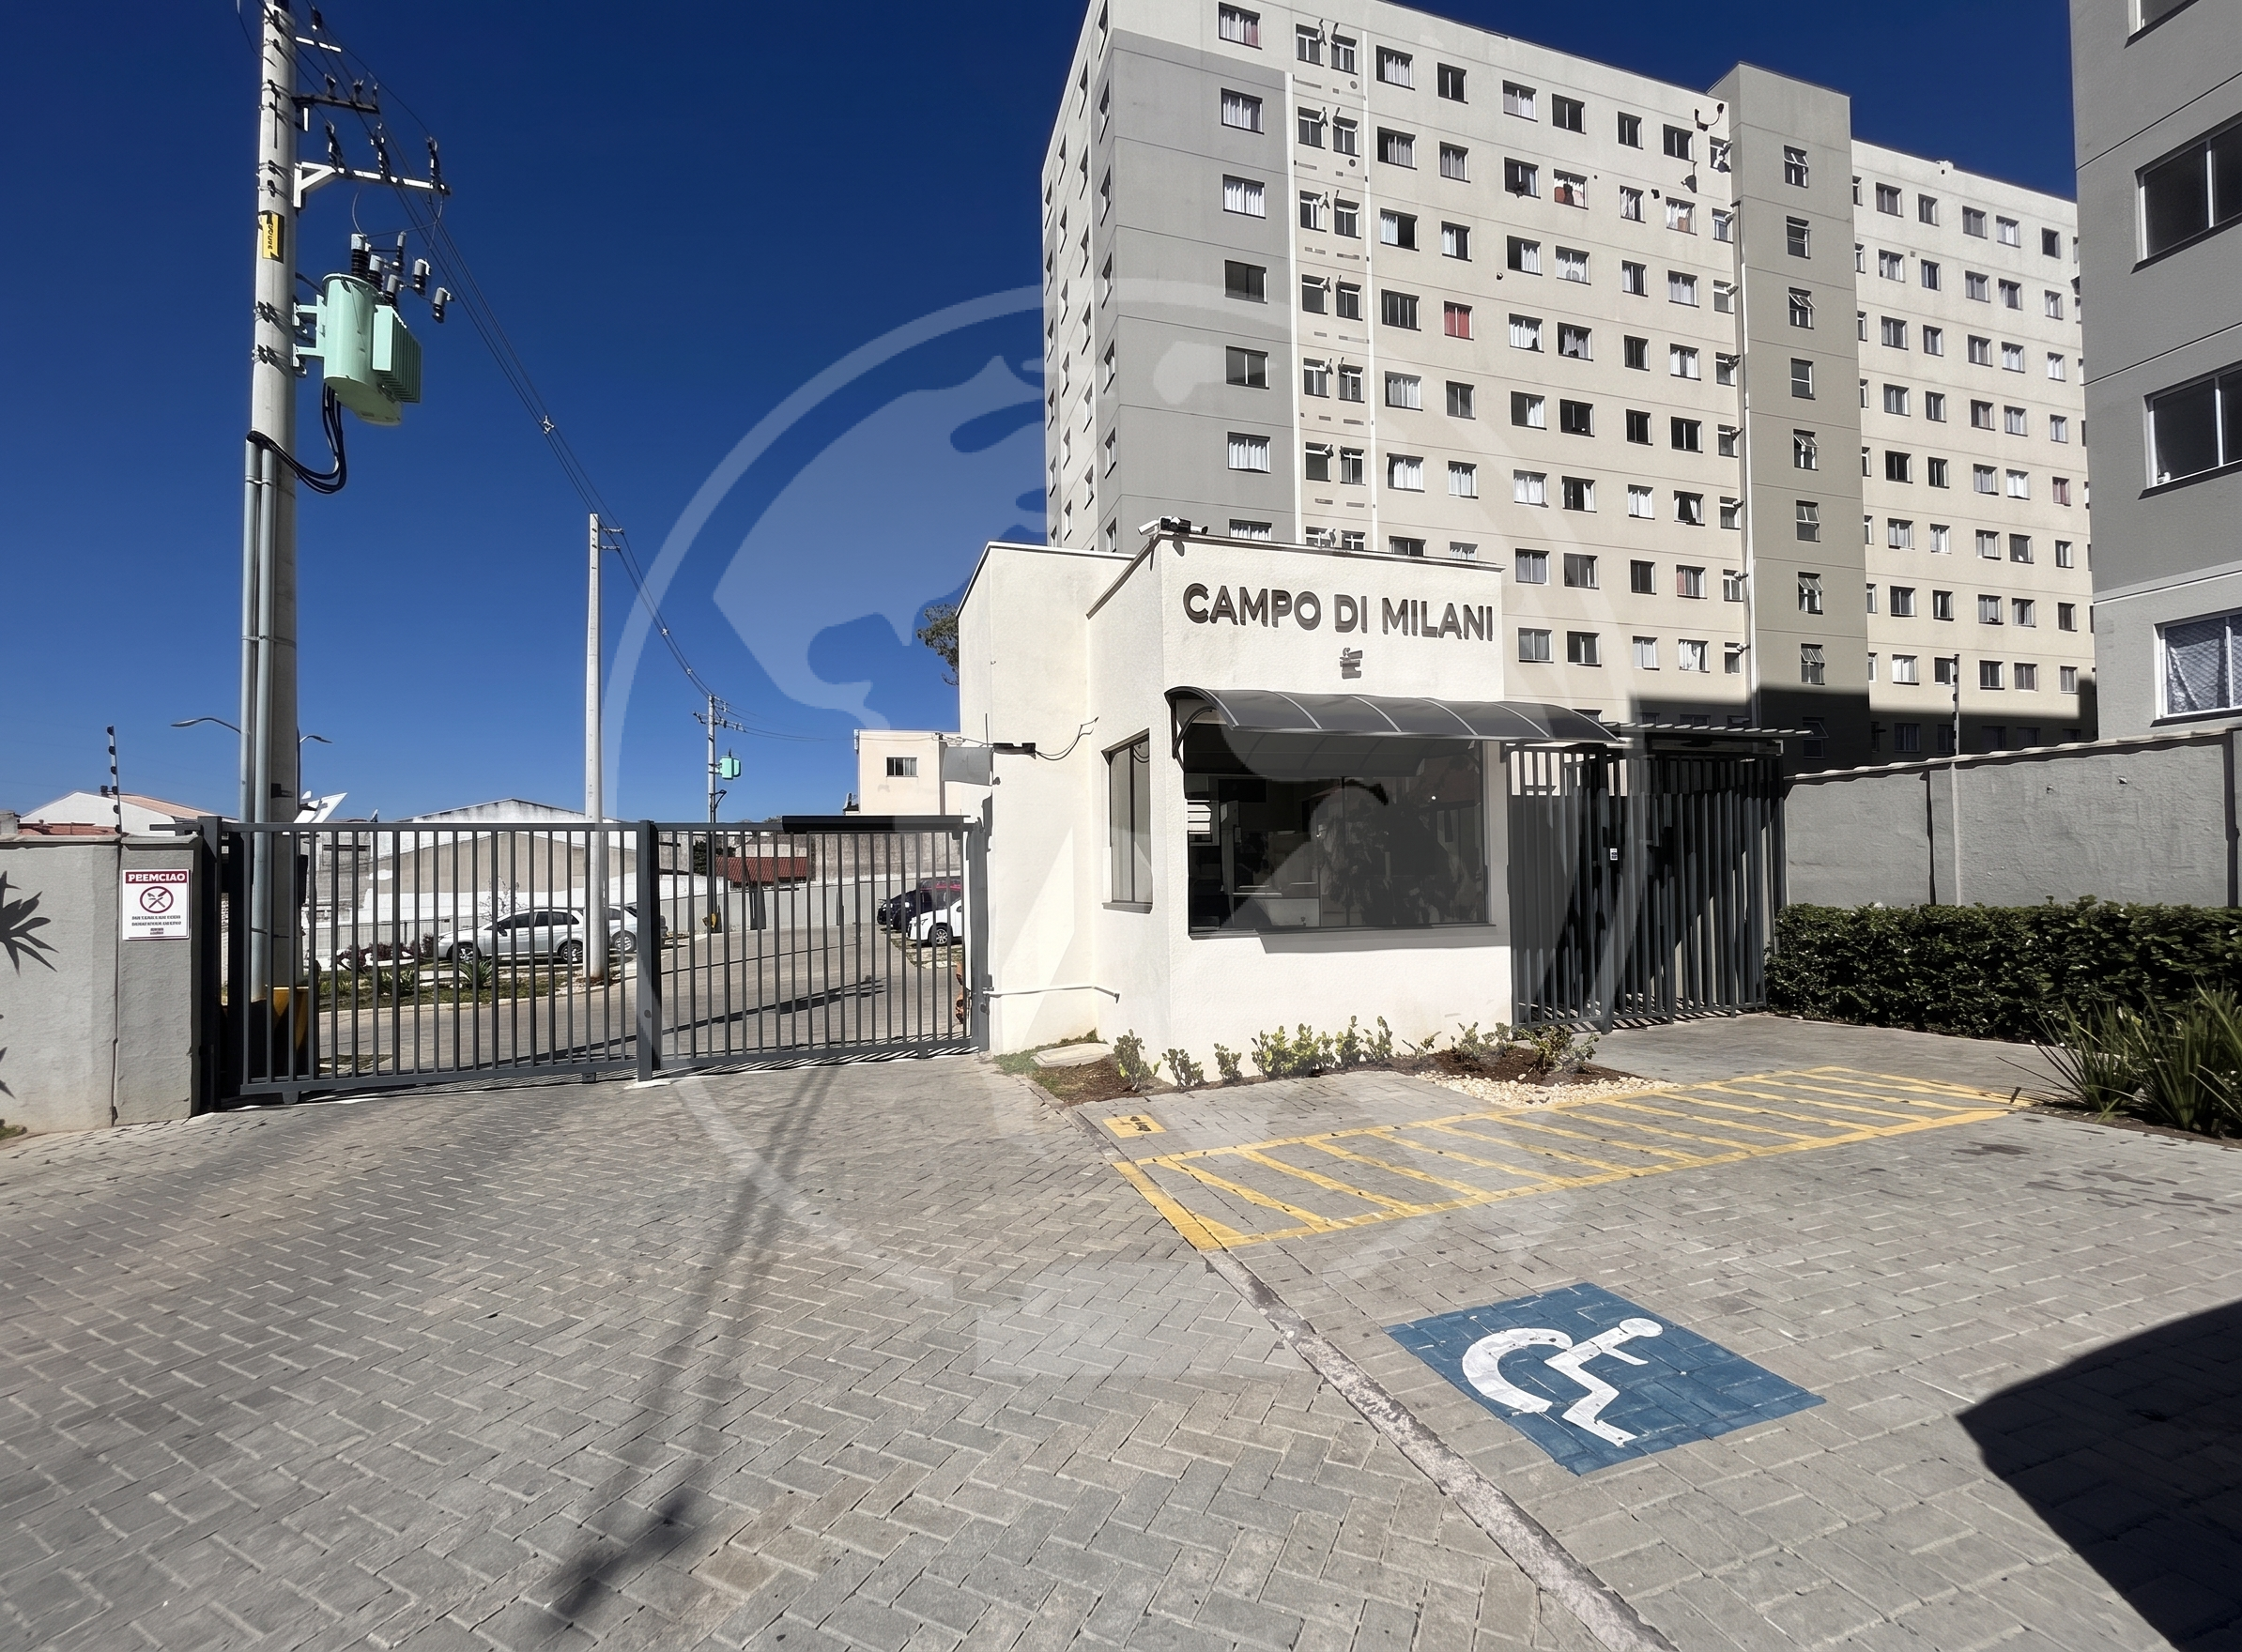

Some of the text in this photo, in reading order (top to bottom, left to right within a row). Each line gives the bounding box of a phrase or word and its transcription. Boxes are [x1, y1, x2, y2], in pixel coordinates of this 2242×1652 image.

[1183, 583, 1493, 641] CAMPO DI MILANI
